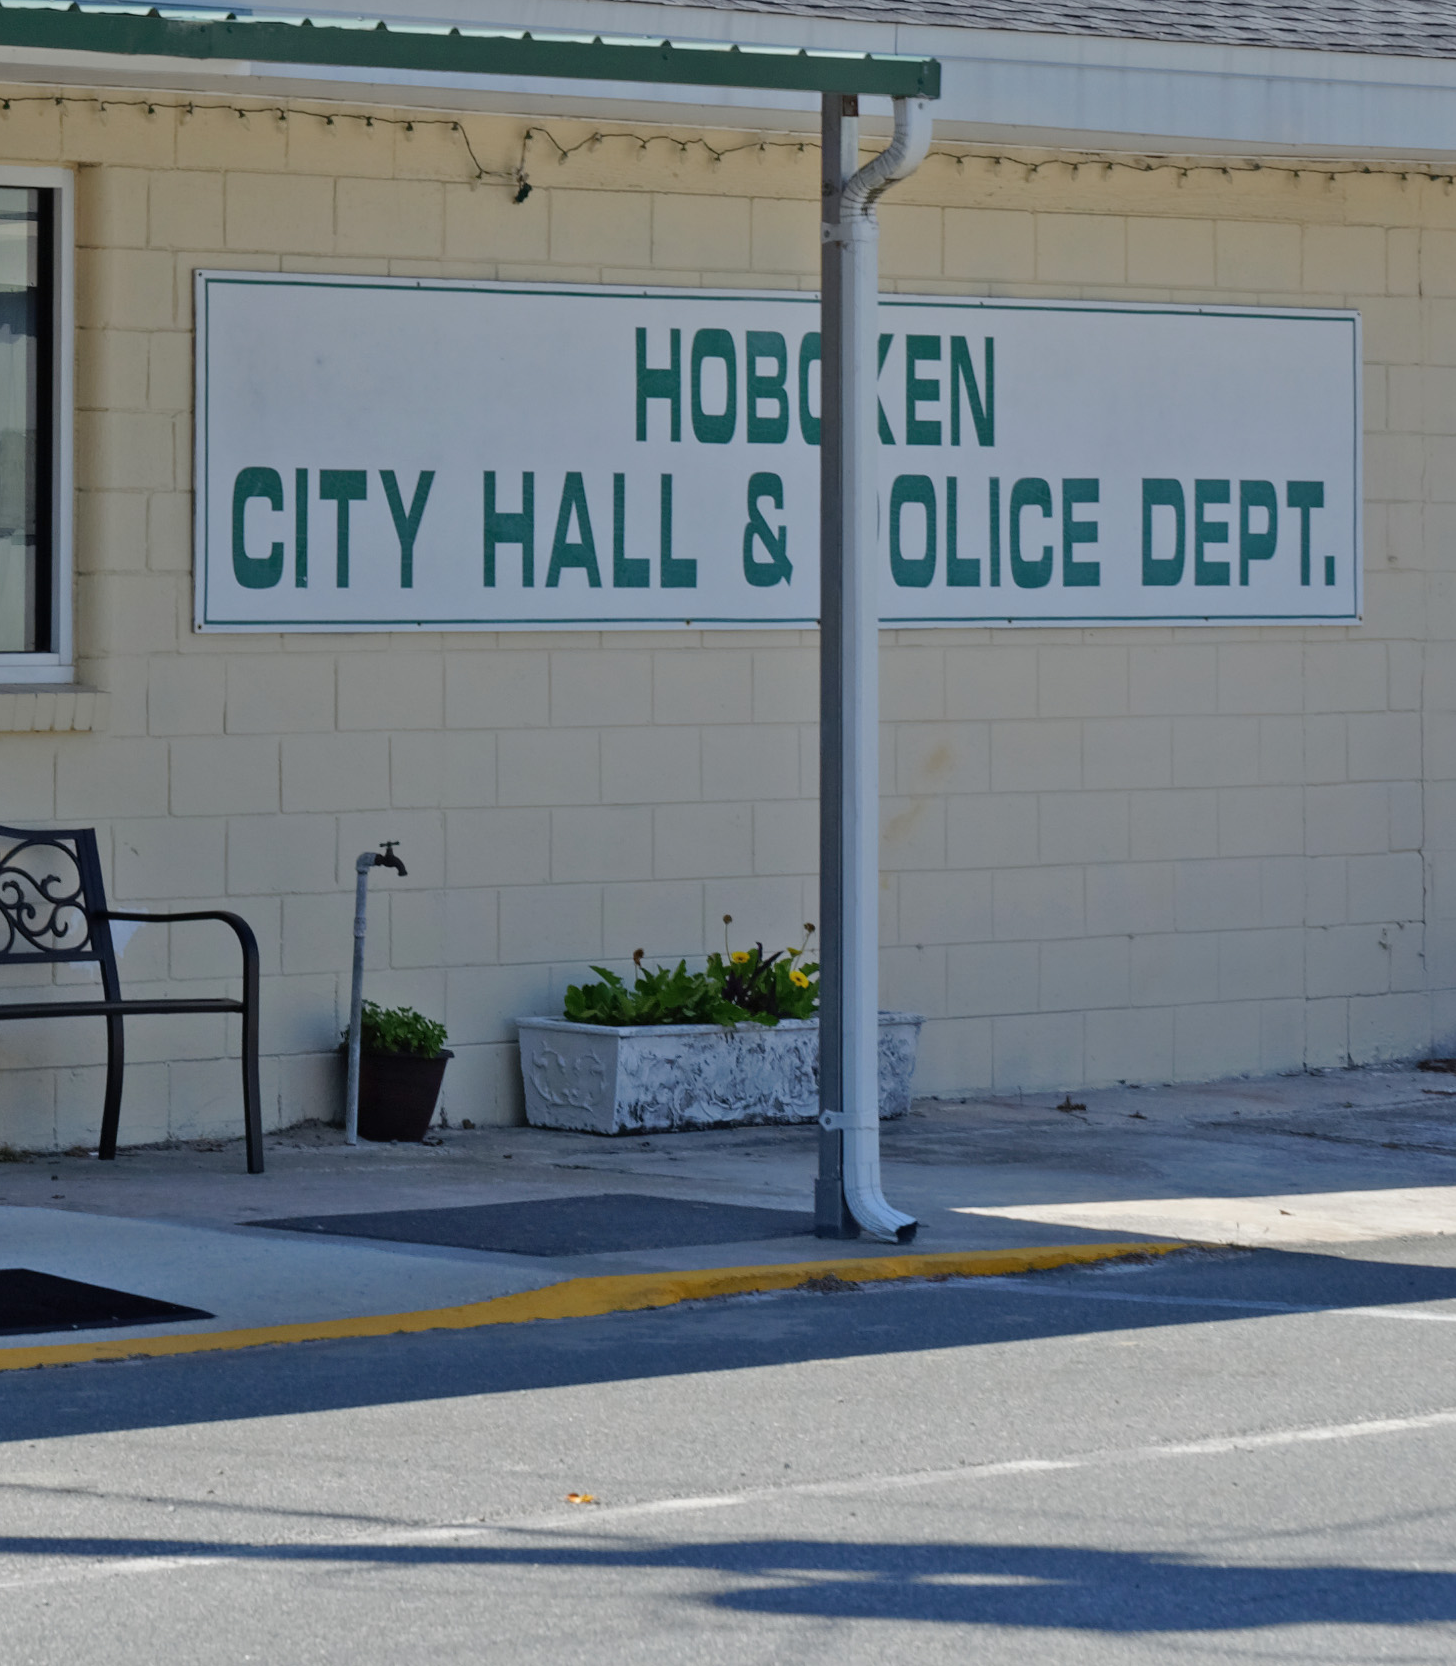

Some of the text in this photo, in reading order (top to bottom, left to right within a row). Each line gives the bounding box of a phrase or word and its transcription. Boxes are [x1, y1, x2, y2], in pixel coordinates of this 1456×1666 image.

[232, 466, 1336, 589] CITY HALL & OLICE DEPT.
